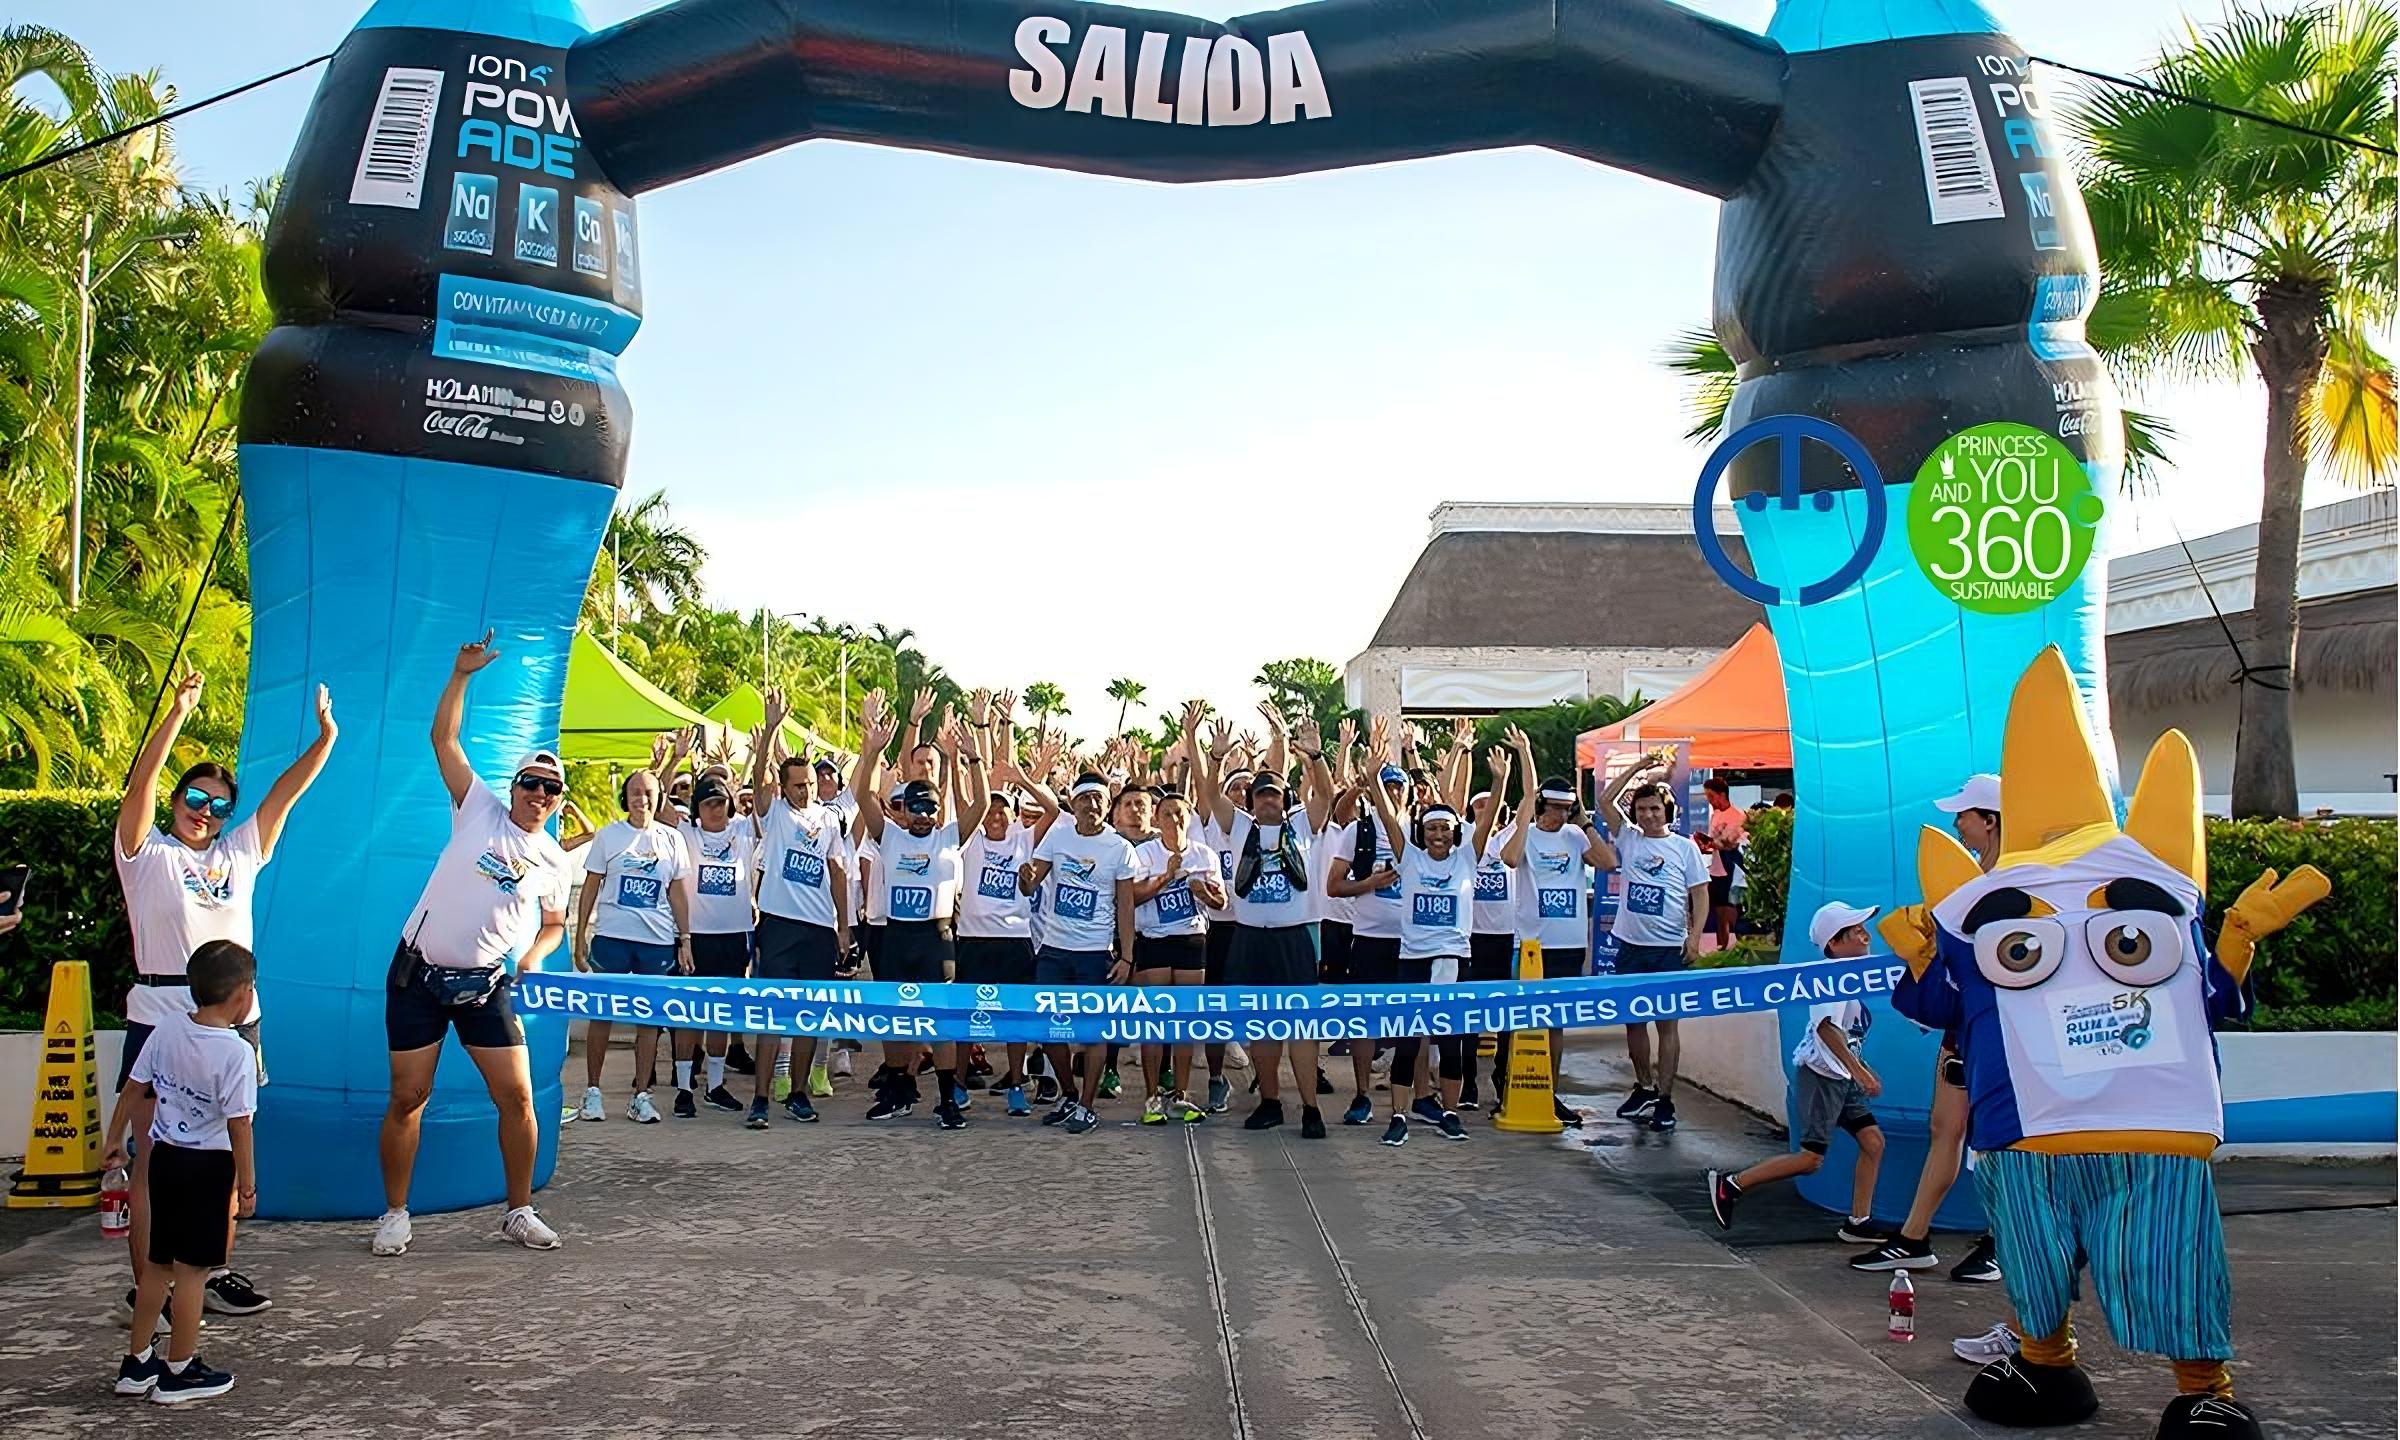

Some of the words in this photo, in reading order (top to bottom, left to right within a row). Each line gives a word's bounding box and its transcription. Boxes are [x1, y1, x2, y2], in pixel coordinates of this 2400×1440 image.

[1009, 16, 1332, 126] SALIDA
[462, 81, 582, 138] POW
[457, 118, 575, 180] ADE
[454, 182, 490, 220] Na
[527, 197, 550, 234] K
[663, 998, 734, 1025] QUE
[745, 1005, 786, 1031] EL
[795, 1006, 938, 1036] CÁNCER
[1101, 1018, 1234, 1040] JUNTOS
[1245, 1017, 1368, 1040] SOMOS
[1380, 1008, 1452, 1038] MÁS
[1464, 998, 1618, 1034] FUERTES
[1629, 991, 1702, 1018] QUE
[1712, 987, 1754, 1010] EL
[1763, 965, 1907, 1004] CÁNCER
